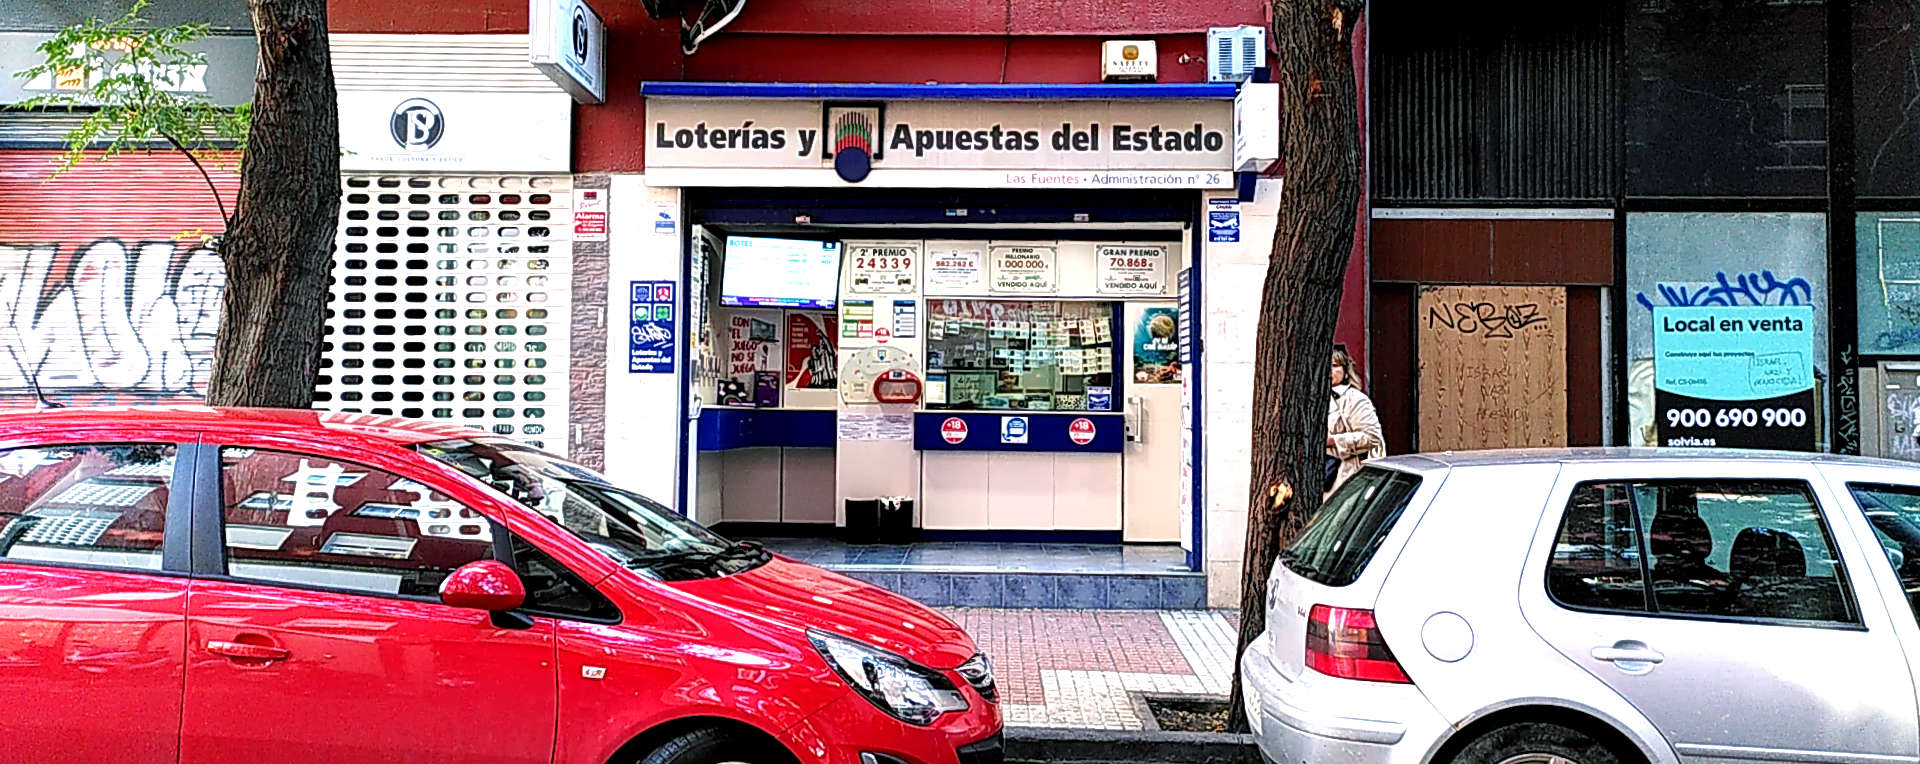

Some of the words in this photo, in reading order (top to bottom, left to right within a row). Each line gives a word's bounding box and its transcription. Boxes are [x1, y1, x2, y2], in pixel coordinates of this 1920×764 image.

[655, 121, 786, 149] Loterías
[797, 128, 817, 156] y
[889, 122, 1040, 157] Apuestas
[1051, 123, 1099, 151] del
[1112, 123, 1223, 151] Estado
[1005, 172, 1028, 185] Las
[1031, 172, 1080, 185] Fuentes
[1091, 172, 1183, 185] Administración
[1205, 172, 1221, 185] 26
[575, 212, 604, 220] Alarma
[872, 248, 908, 257] PREMIO
[1102, 248, 1127, 256] GRAN
[1128, 249, 1160, 257] PREMIO
[1109, 257, 1148, 268] 70.868
[997, 281, 1028, 289] VENDIDO
[1029, 280, 1048, 289] AQUÍ
[1104, 282, 1137, 290] VENDIDO
[1139, 281, 1158, 290] AQUÍ
[731, 316, 750, 328] CON
[1663, 316, 1715, 332] Local
[1719, 319, 1744, 332] en
[1749, 316, 1804, 332] venta
[731, 328, 741, 340] EL
[731, 339, 758, 352] JUEGO
[730, 352, 745, 363] NO
[746, 351, 756, 363] SE
[730, 363, 756, 375] JUEGA
[1666, 408, 1712, 428] 900
[1715, 408, 1758, 428] 690
[1761, 408, 1807, 428] 900
[946, 420, 962, 431] +18
[1073, 421, 1090, 431] +18
[1667, 436, 1717, 447] solvia.es
